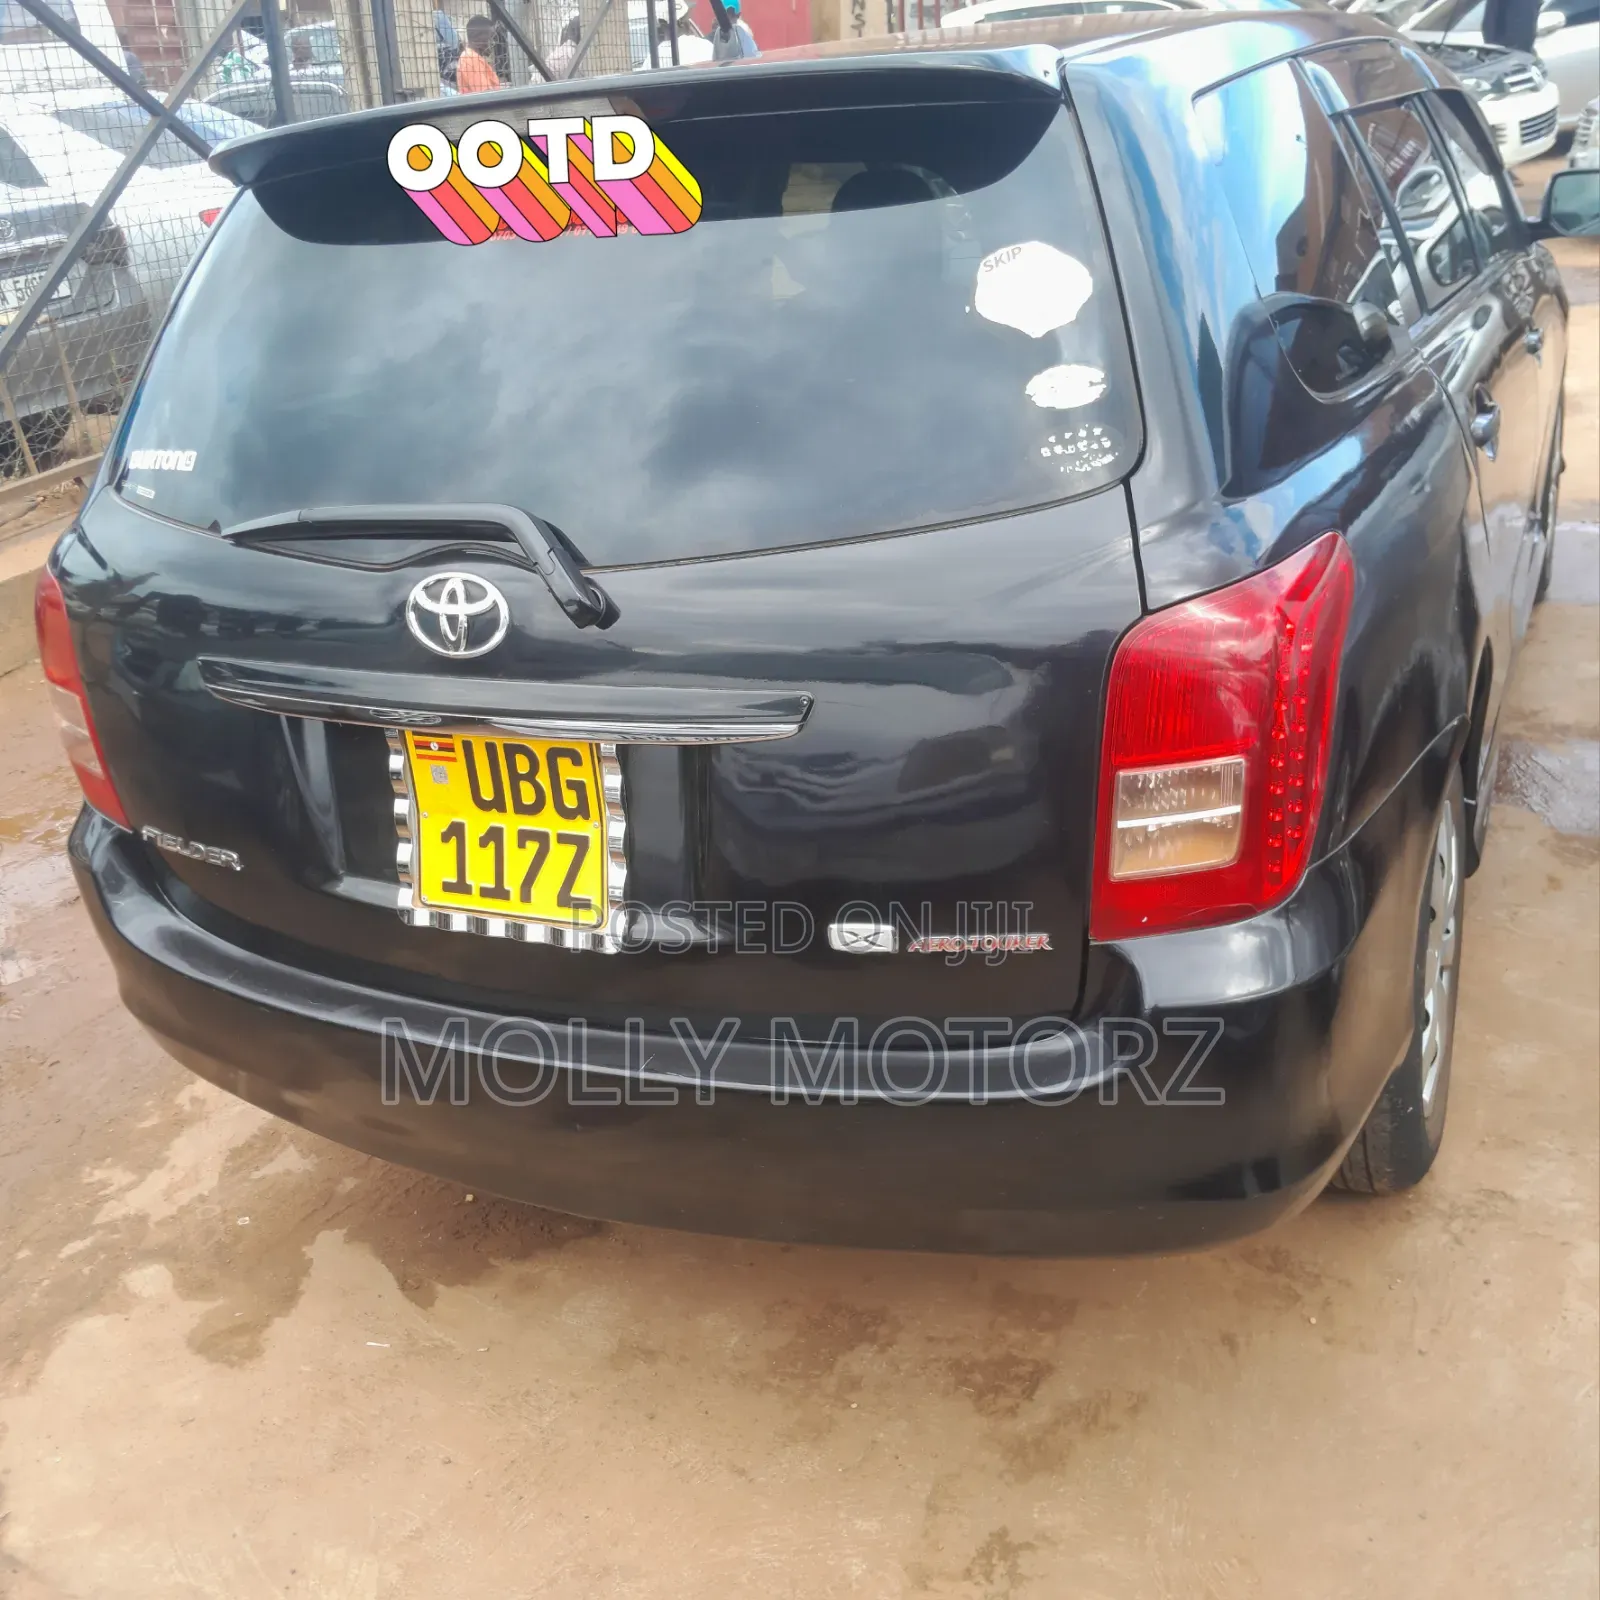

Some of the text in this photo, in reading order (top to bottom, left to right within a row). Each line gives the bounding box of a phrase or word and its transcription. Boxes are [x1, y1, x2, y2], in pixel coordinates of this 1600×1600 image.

[982, 246, 1022, 273] SKIP
[461, 739, 591, 821] UBG
[141, 824, 242, 872] FIELDER
[440, 820, 593, 911] 117Z
